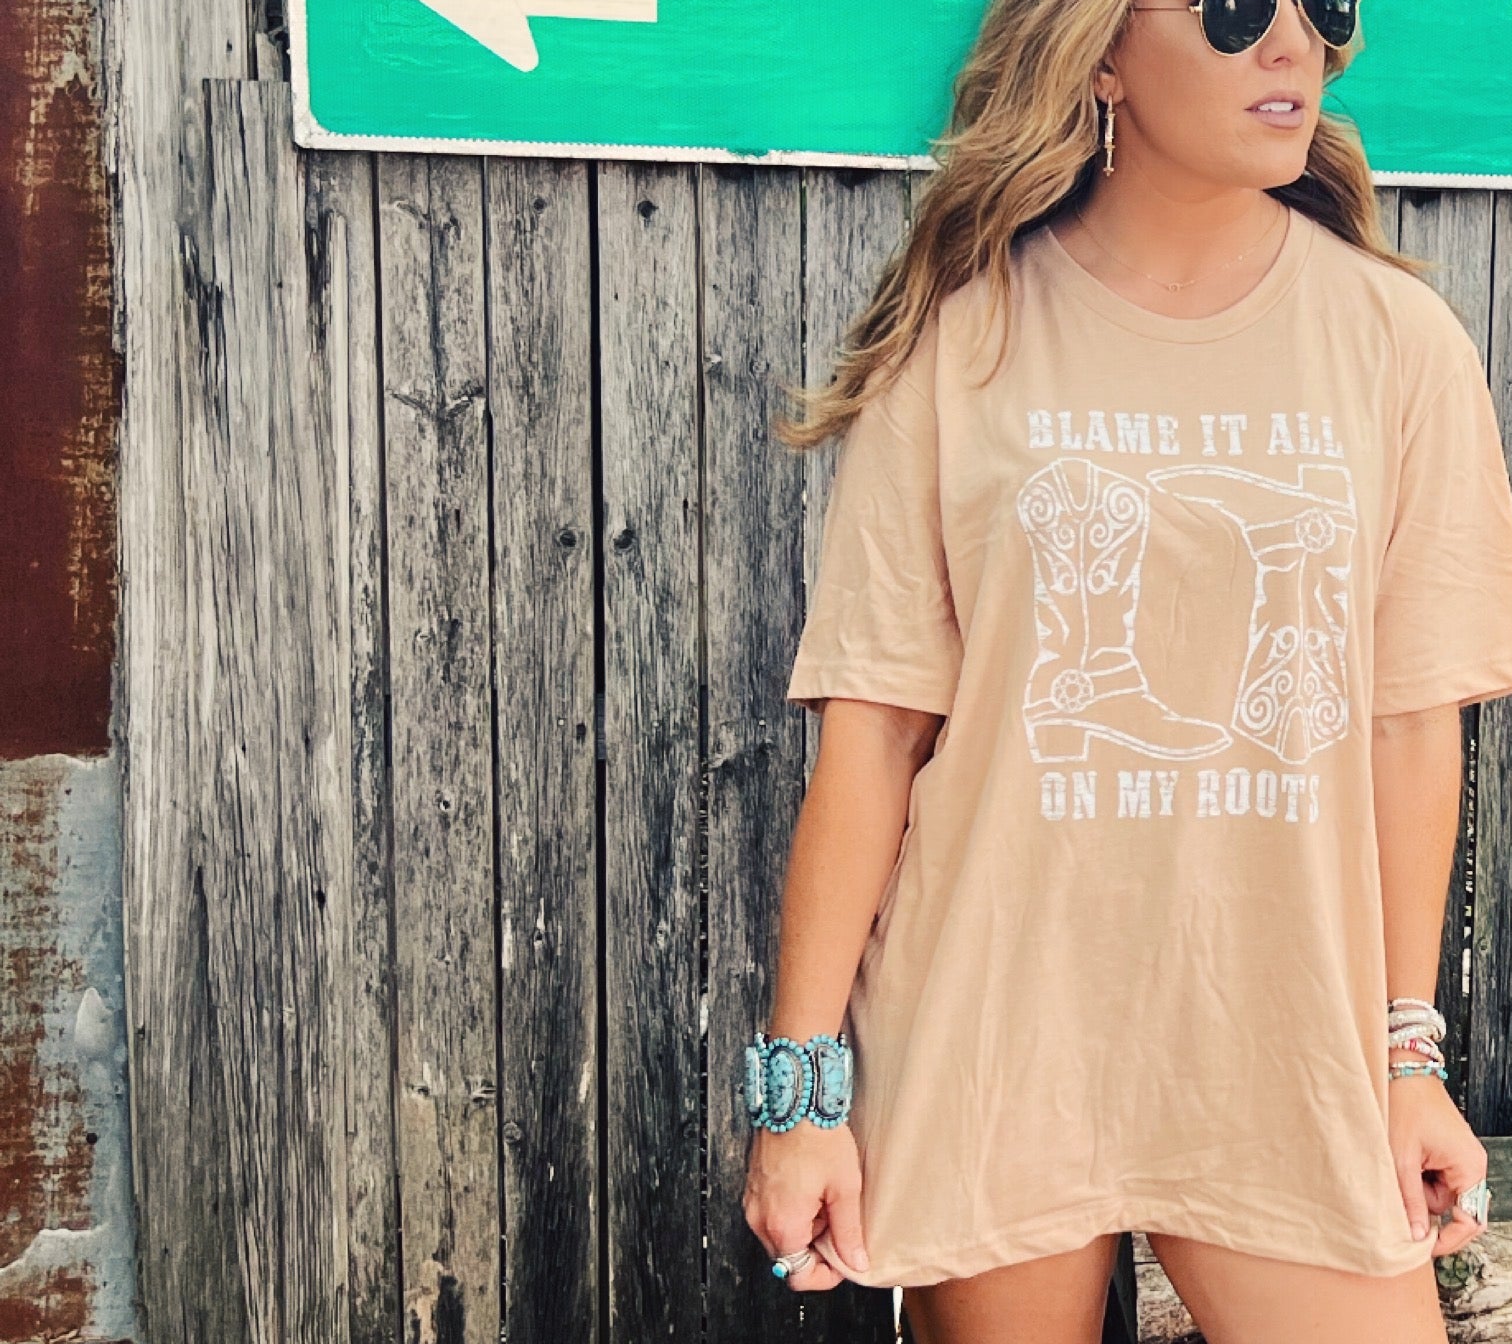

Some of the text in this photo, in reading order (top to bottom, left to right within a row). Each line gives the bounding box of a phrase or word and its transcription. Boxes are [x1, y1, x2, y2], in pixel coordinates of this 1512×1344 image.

[1027, 409, 1344, 456] BLAME IT ALL
[1040, 770, 1096, 820] ON
[1117, 770, 1179, 818] MY
